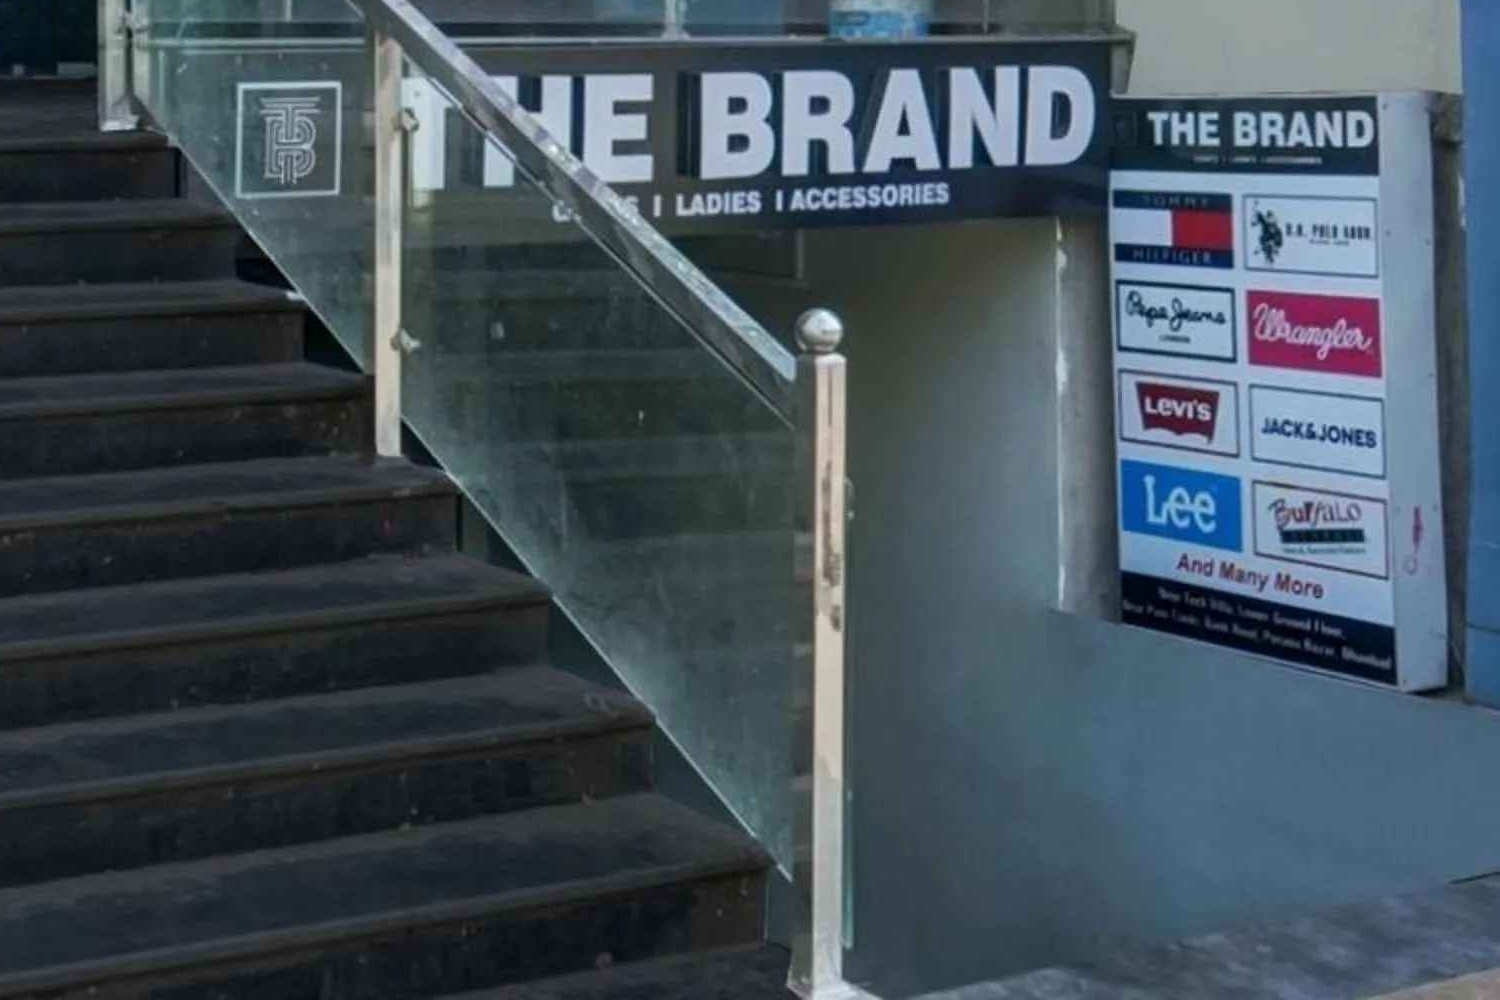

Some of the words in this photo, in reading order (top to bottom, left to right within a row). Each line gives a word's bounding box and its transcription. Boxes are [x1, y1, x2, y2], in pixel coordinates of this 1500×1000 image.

[401, 72, 654, 190] THE
[700, 65, 1096, 181] BRAND
[1147, 111, 1220, 147] THE
[1233, 109, 1375, 148] BRAND
[676, 188, 761, 217] LADIES
[790, 183, 950, 213] ACCESSORIES
[1132, 247, 1213, 265] HILFIGER
[1125, 290, 1169, 329] Pepe
[1169, 297, 1226, 332] Jeans
[1253, 302, 1376, 361] Wrangler
[1261, 416, 1378, 450] JACK&JONES
[1143, 474, 1218, 534] Lee
[1177, 552, 1214, 578] And
[1219, 559, 1269, 592] Many
[1274, 571, 1325, 600] More
